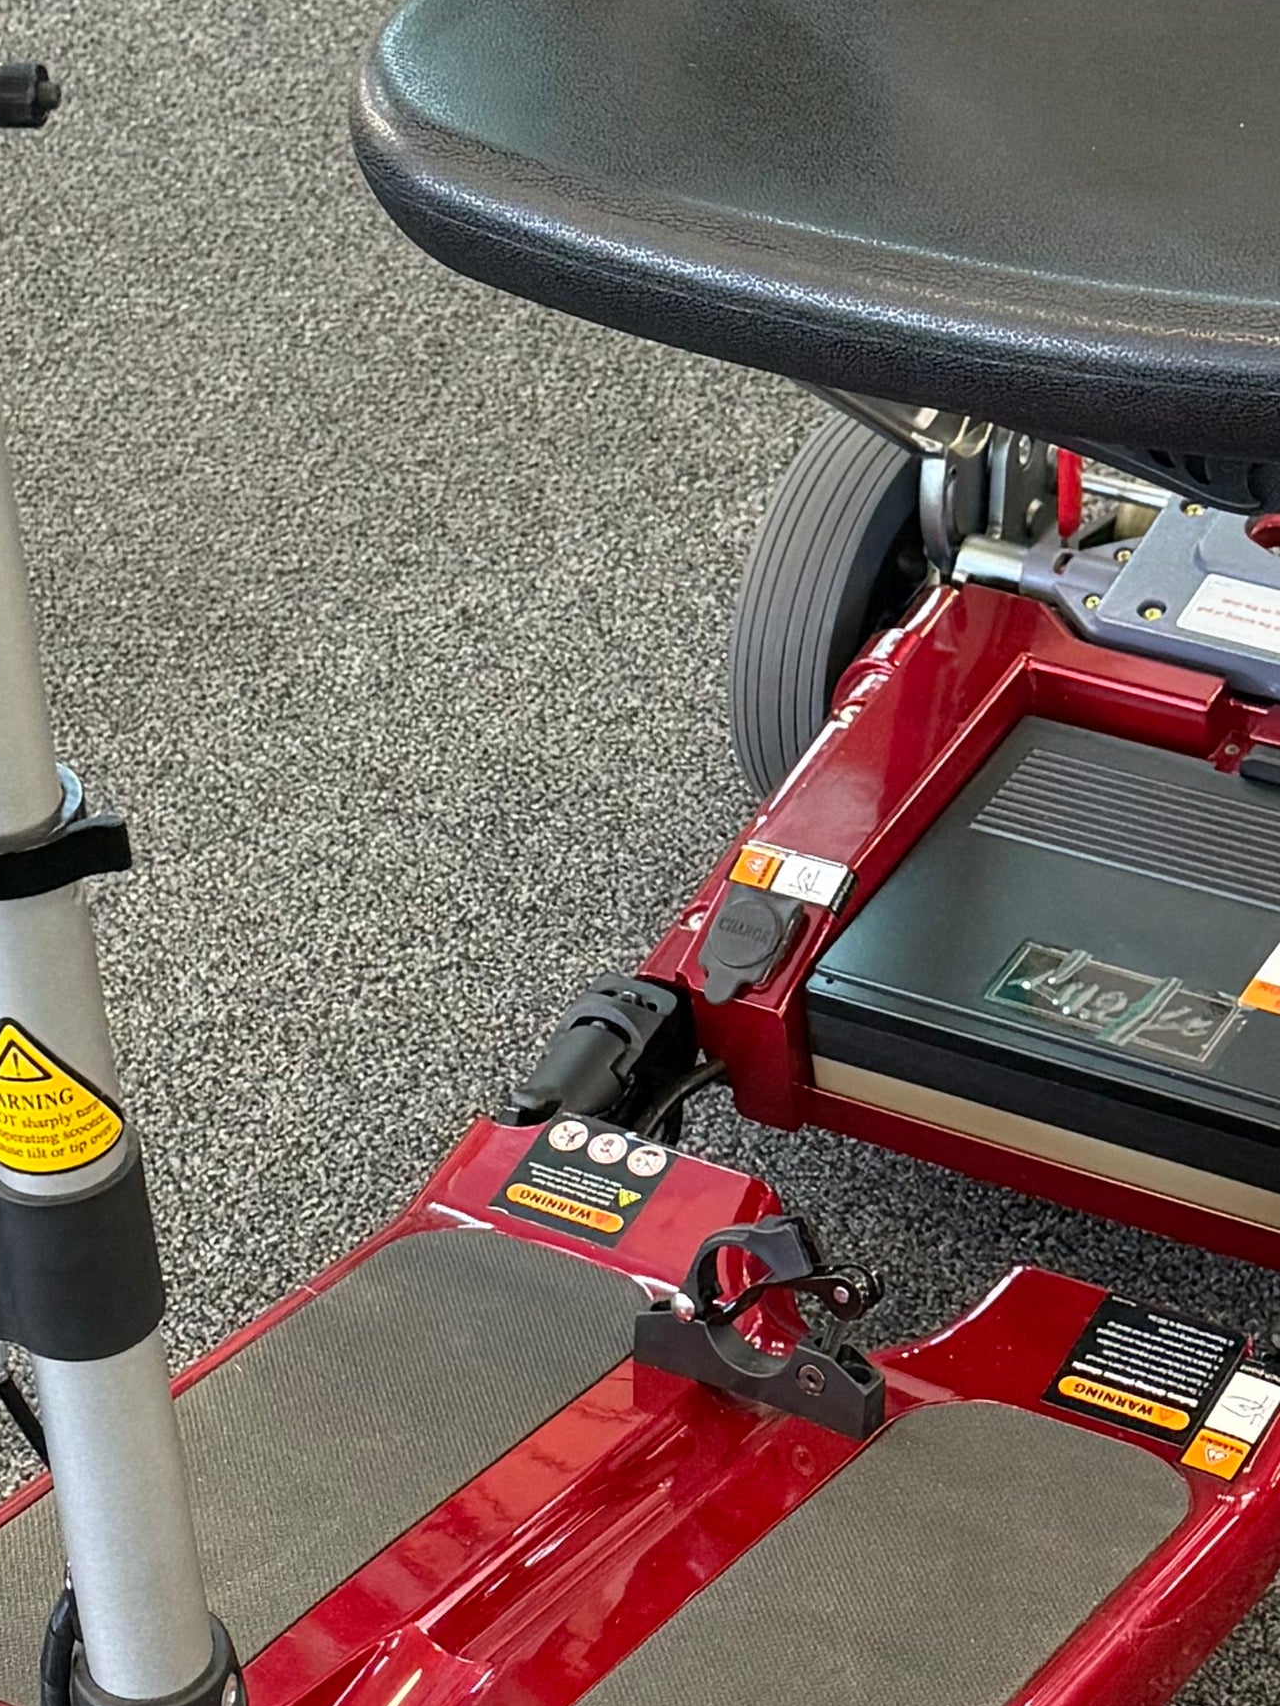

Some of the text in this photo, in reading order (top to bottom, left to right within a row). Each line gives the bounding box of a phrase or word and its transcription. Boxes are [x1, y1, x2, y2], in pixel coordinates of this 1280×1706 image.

[22, 1112, 73, 1131] sharply
[0, 1127, 60, 1146] operating
[27, 1146, 47, 1159] tilt
[51, 1144, 65, 1158] or
[69, 1141, 87, 1157] tip
[519, 1190, 591, 1220] WARNING
[1074, 1383, 1153, 1416] WARNING
